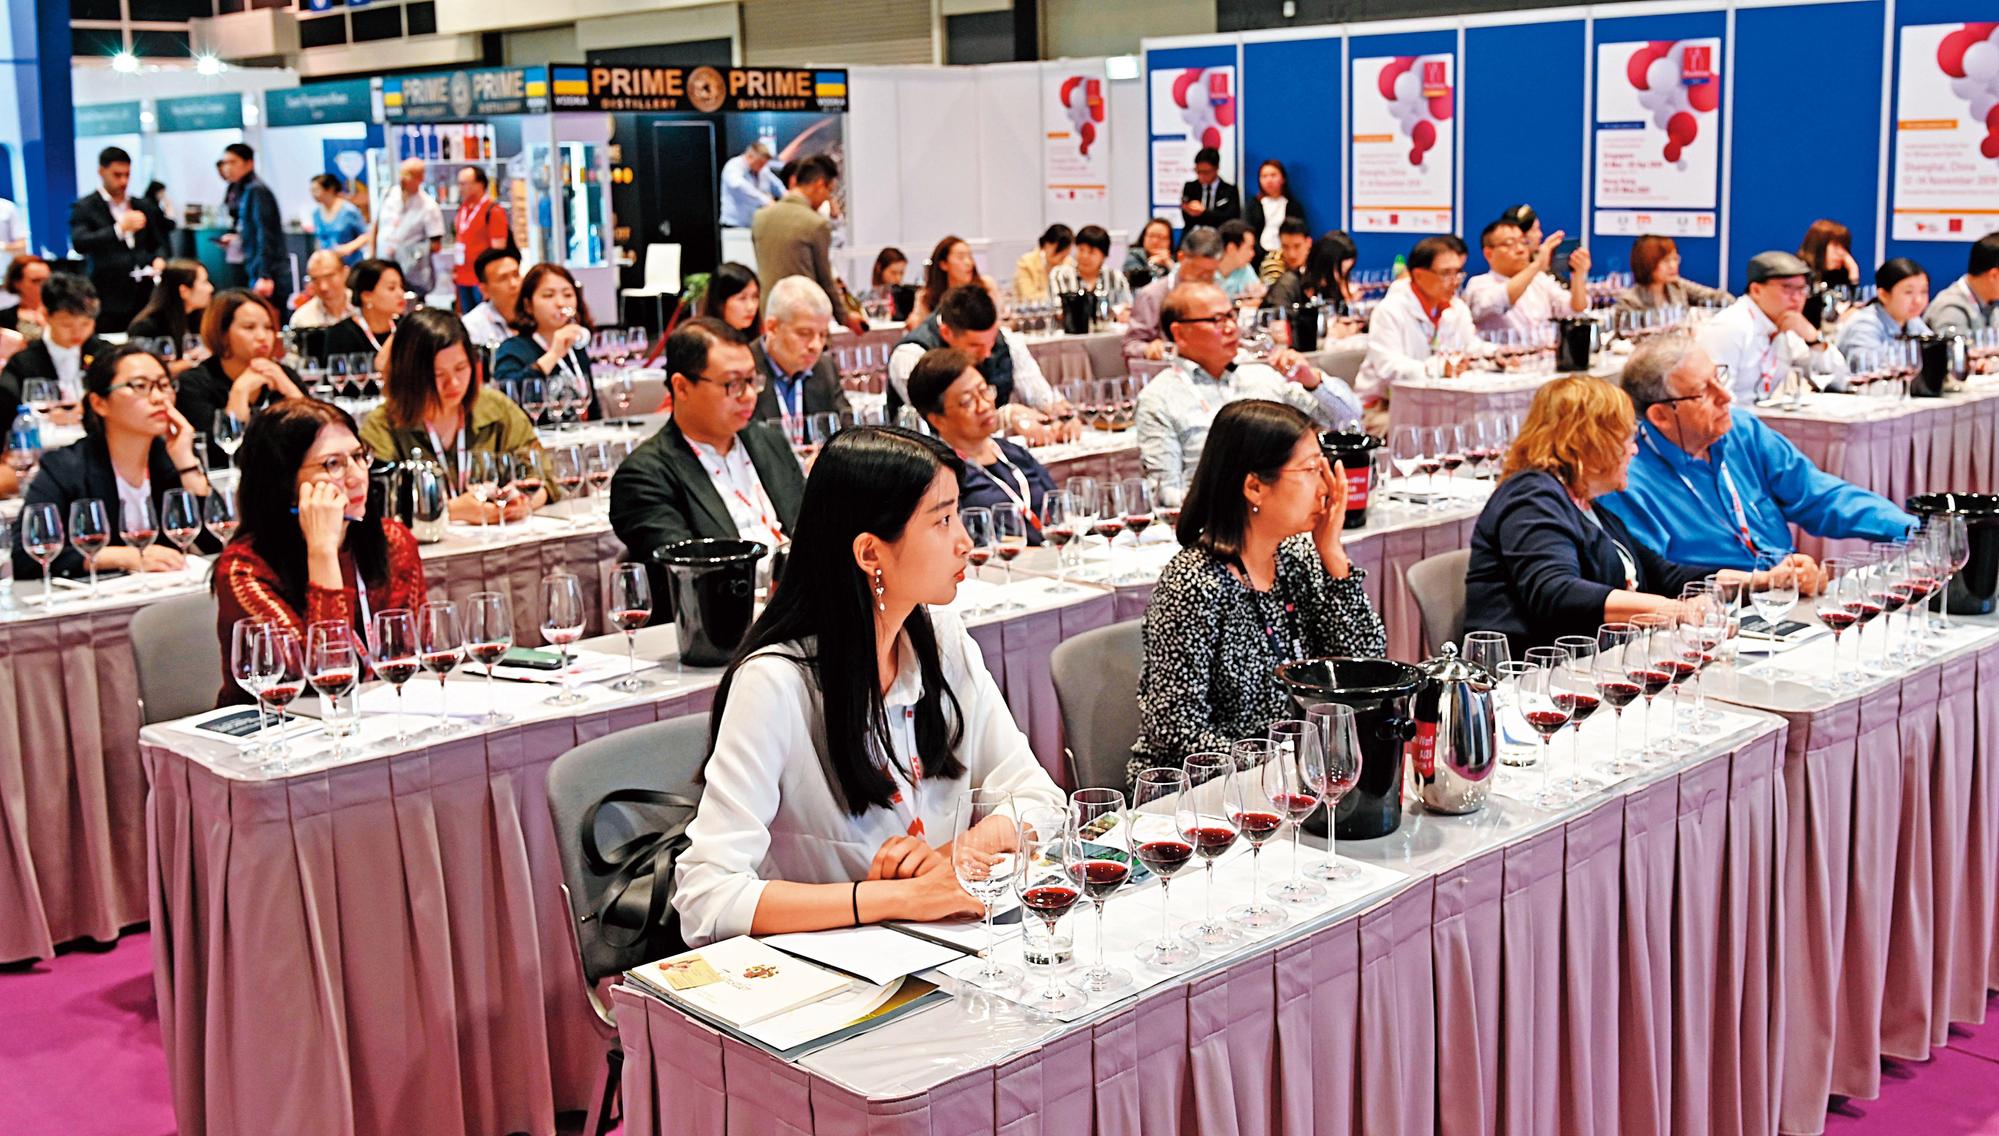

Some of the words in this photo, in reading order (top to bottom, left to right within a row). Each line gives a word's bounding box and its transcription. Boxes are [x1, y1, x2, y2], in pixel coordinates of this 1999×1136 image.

[402, 77, 450, 105] PRIME
[472, 70, 525, 98] PRIME
[591, 68, 683, 96] PRIME
[729, 70, 812, 97] PRIME
[601, 98, 677, 110] DISTILLERY
[737, 98, 806, 110] DISTILLERY
